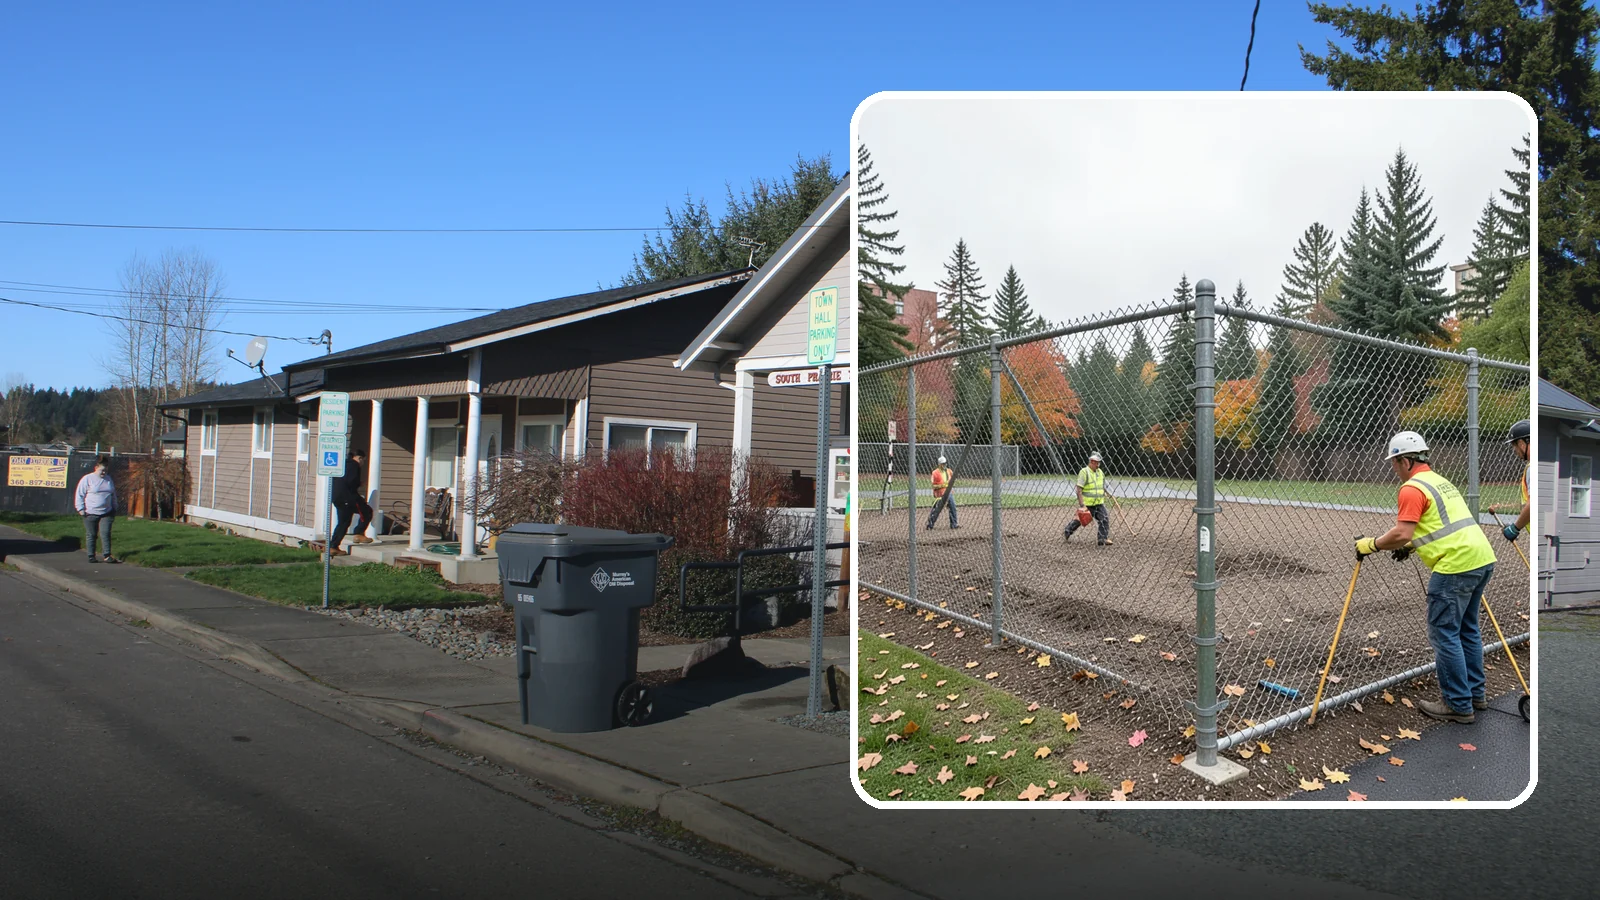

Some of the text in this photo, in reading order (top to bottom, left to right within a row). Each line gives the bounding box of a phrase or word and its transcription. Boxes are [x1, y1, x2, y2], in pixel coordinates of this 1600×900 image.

[815, 294, 833, 308] TOWN
[814, 311, 831, 324] HALL
[810, 327, 835, 340] PARKING
[813, 344, 831, 357] ONLY
[776, 374, 800, 384] SOUTH
